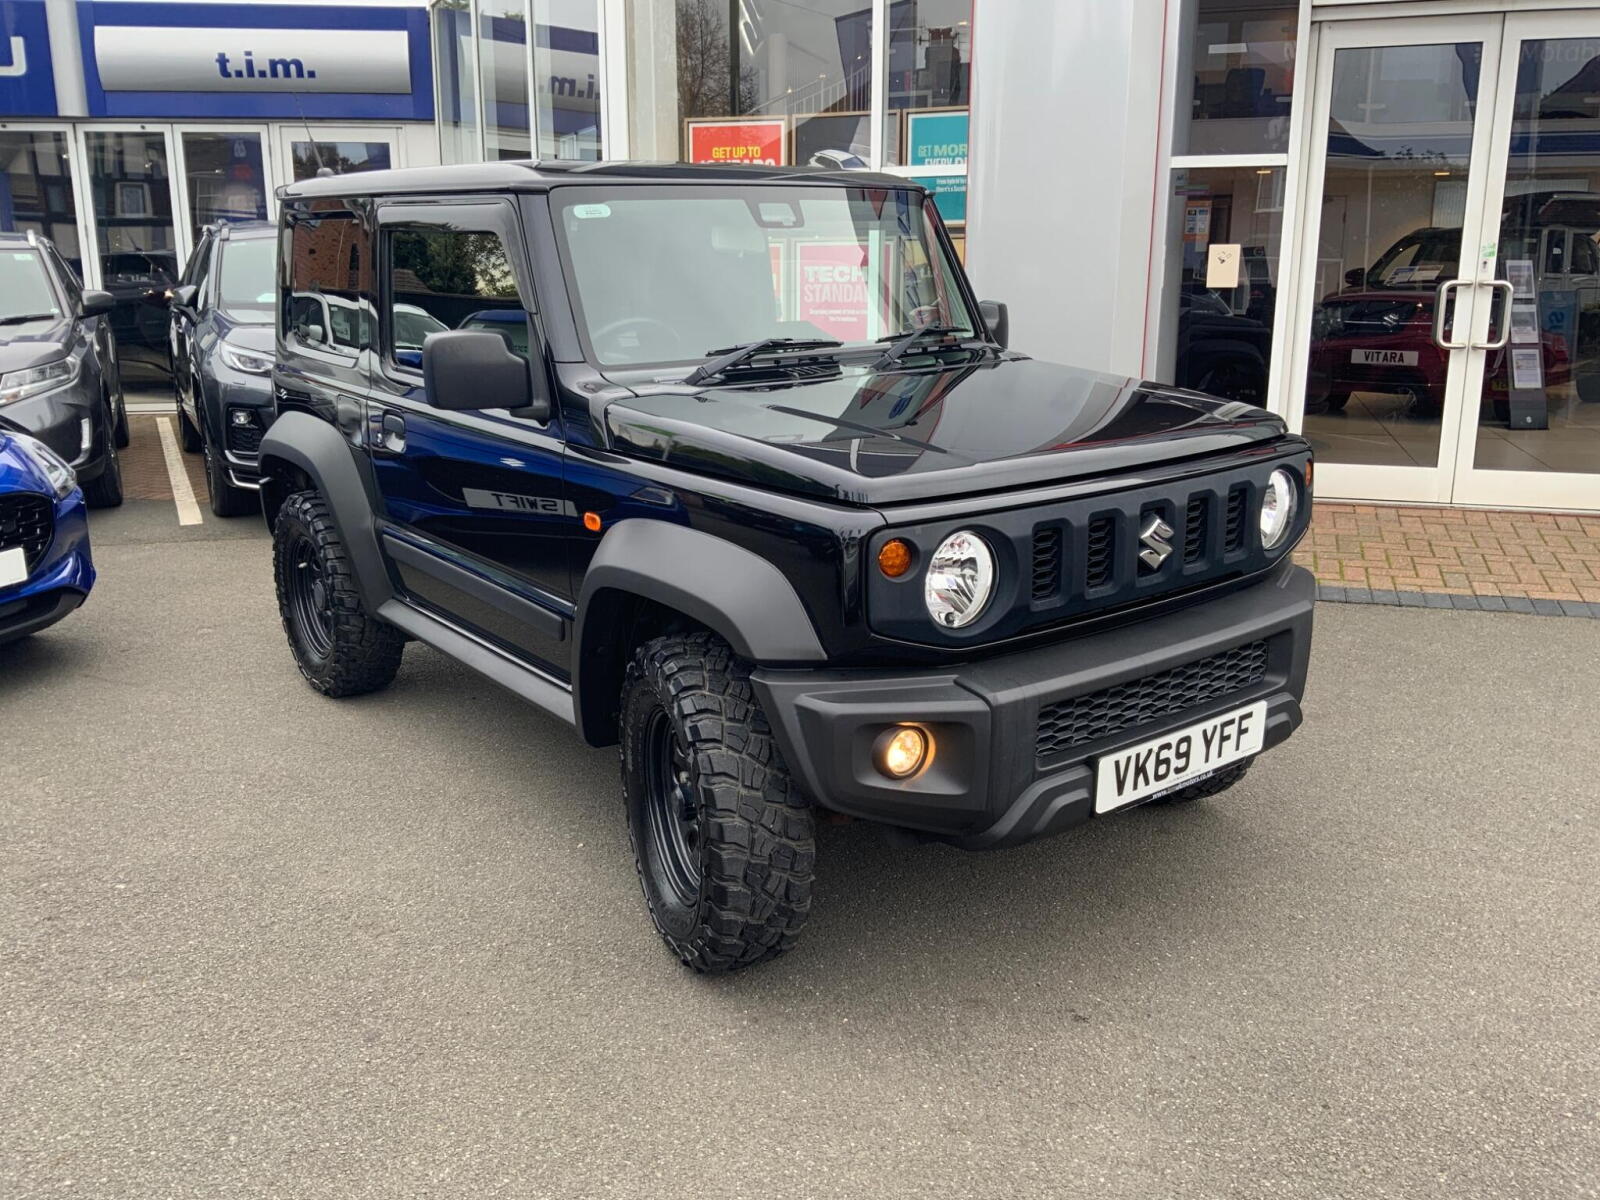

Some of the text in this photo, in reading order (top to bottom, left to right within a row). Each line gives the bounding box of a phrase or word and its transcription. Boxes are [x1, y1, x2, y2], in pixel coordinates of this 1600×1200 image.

[215, 51, 316, 78] t.i.m.
[712, 146, 761, 158] GET UP TO
[918, 145, 931, 157] GET
[1364, 352, 1405, 363] VITARA
[1114, 712, 1253, 797] VK69 YFF
